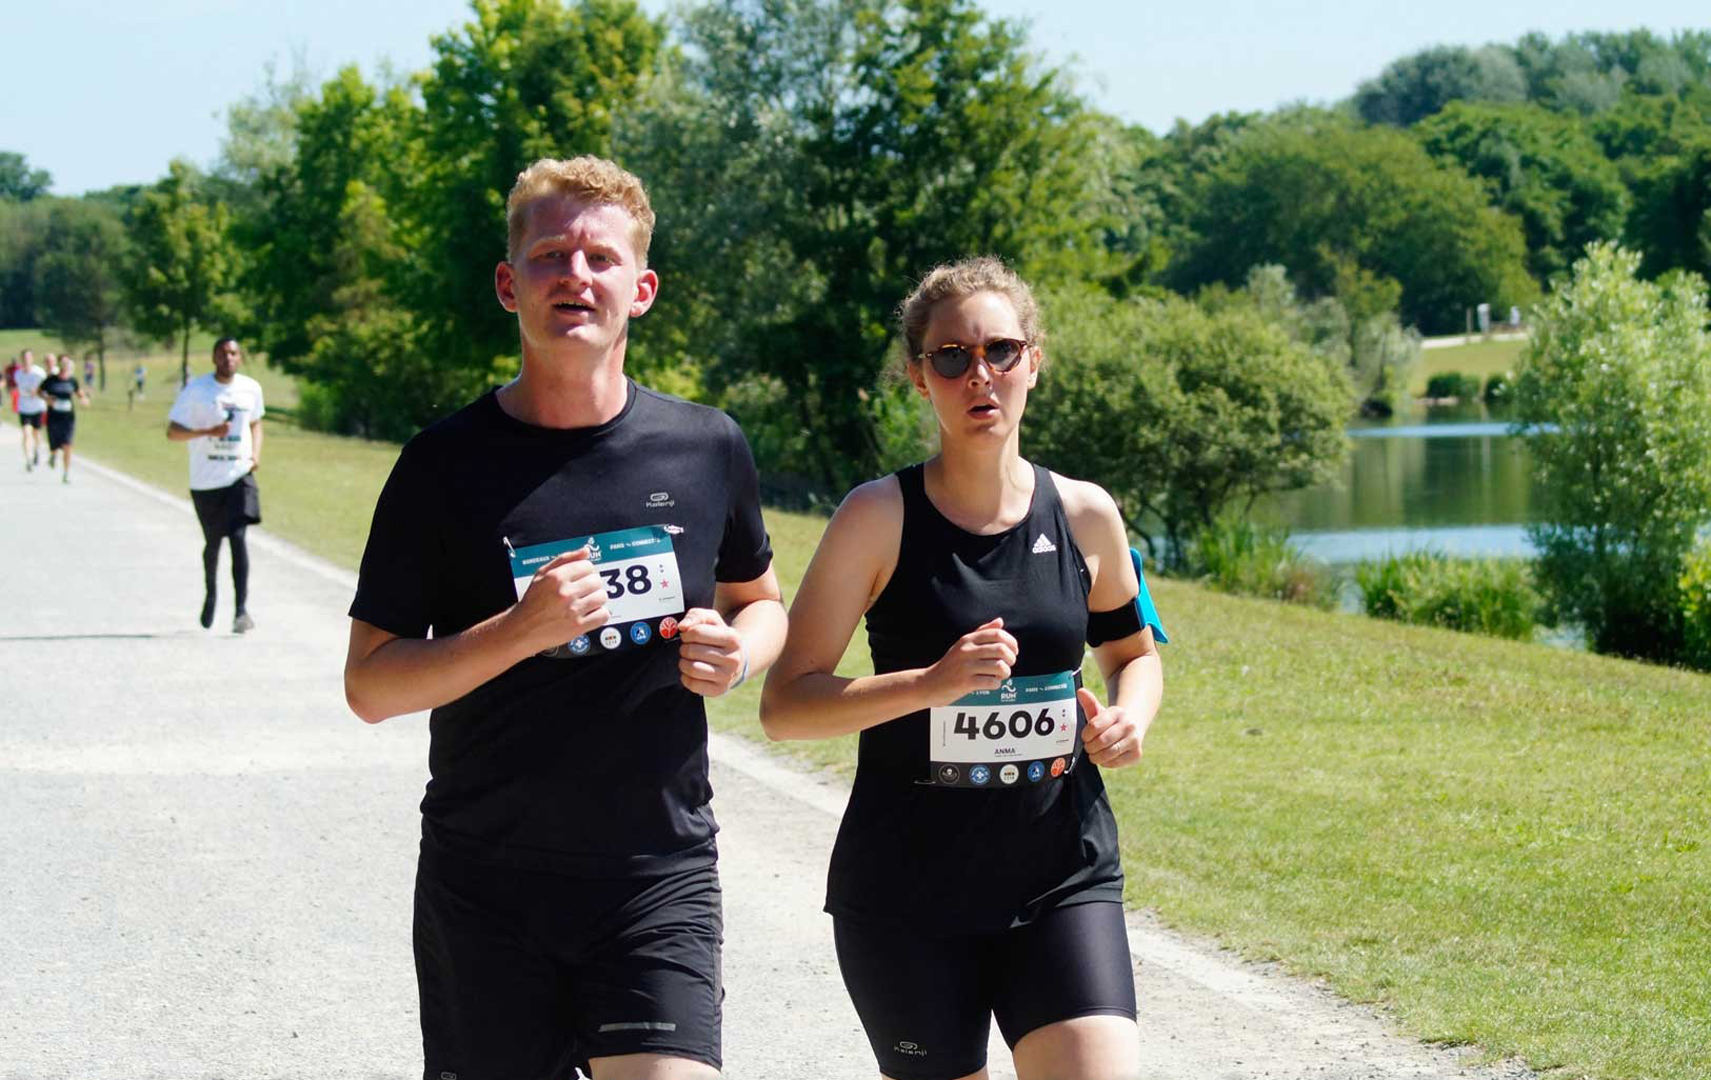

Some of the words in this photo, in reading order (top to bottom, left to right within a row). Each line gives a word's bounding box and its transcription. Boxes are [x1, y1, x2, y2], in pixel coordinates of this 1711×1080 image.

[1032, 544, 1056, 554] adidas
[599, 565, 652, 599] 38
[1000, 692, 1017, 700] RUN
[954, 708, 1055, 740] 4606
